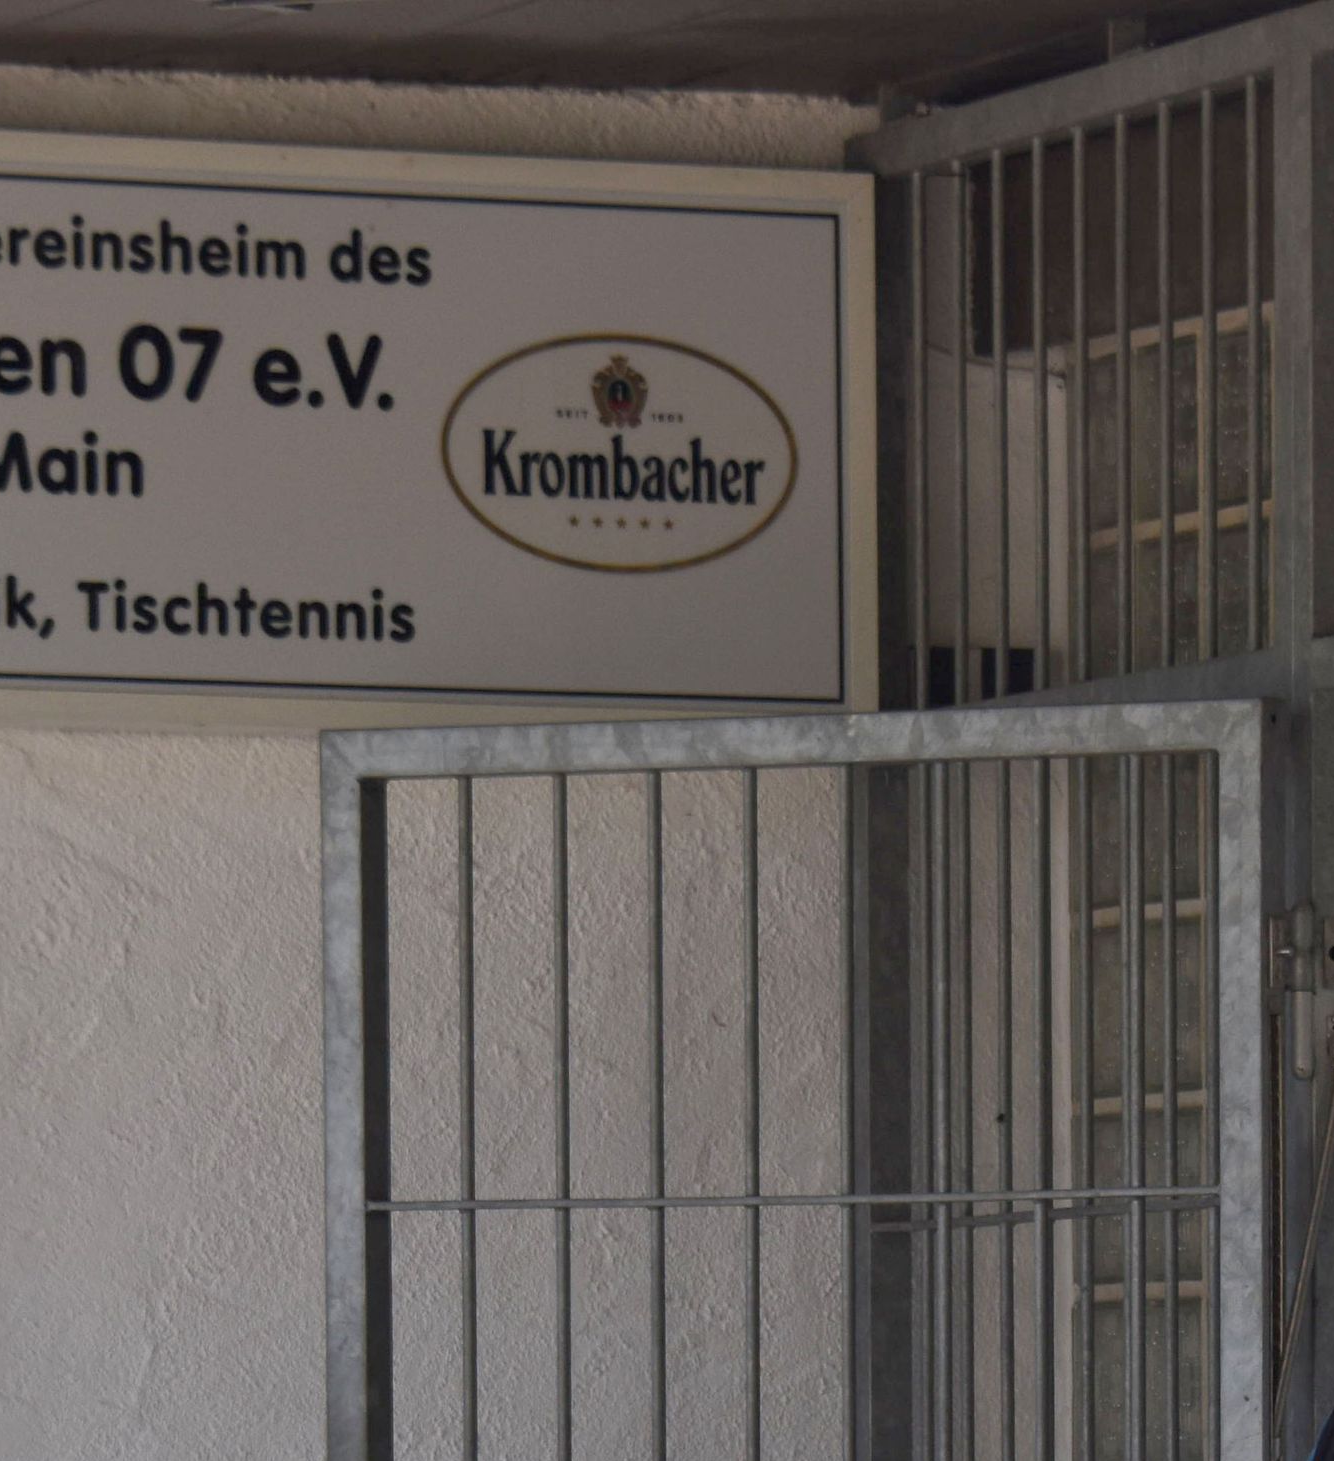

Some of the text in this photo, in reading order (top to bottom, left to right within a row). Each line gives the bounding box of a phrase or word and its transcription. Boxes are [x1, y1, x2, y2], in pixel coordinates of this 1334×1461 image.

[329, 229, 432, 286] des
[119, 323, 223, 402] 07
[253, 333, 395, 412] e.V.
[555, 408, 588, 420] SEIT
[481, 428, 766, 505] Krombacher
[77, 576, 416, 642] Tischtennis
